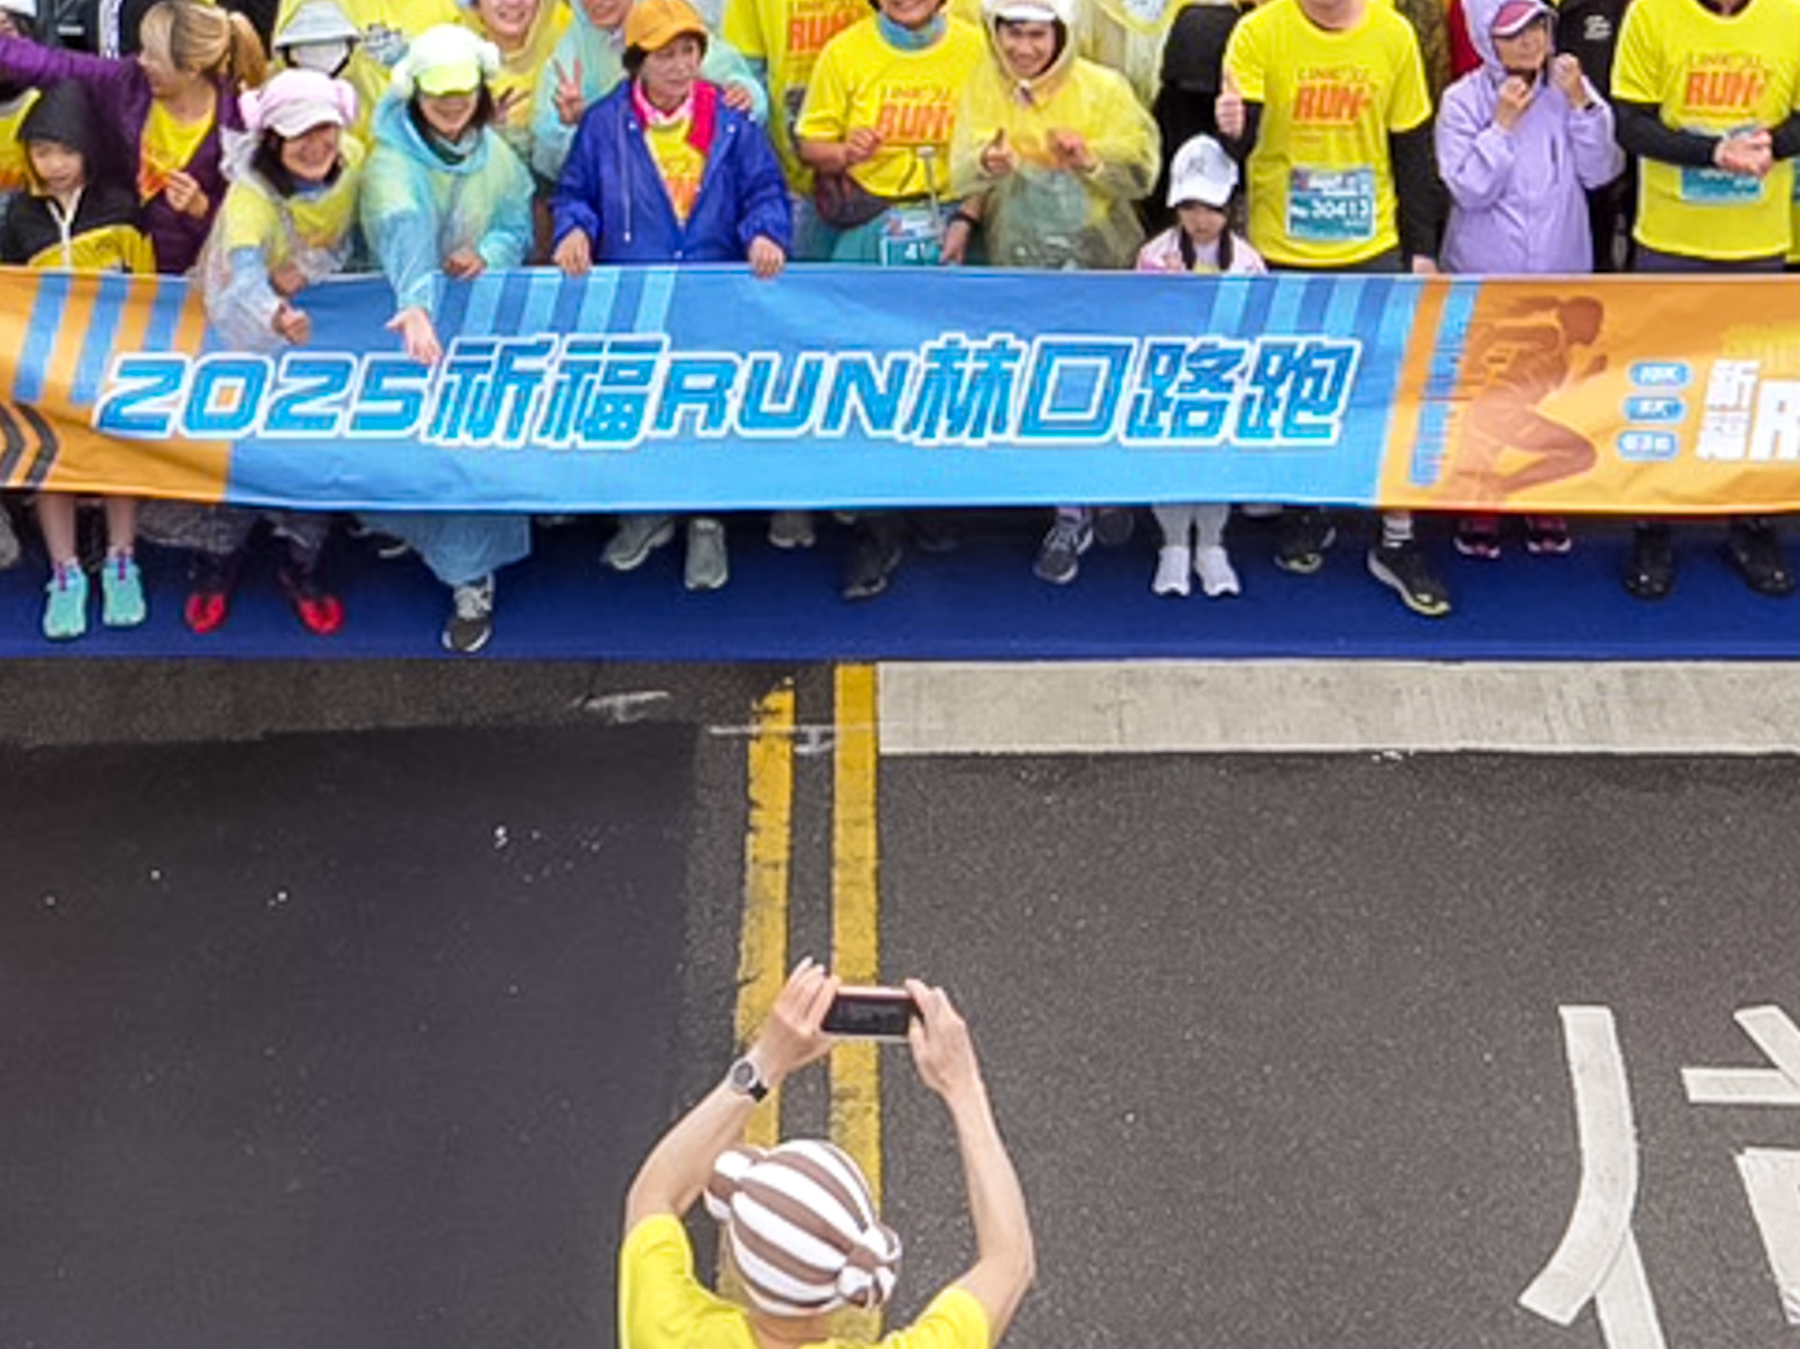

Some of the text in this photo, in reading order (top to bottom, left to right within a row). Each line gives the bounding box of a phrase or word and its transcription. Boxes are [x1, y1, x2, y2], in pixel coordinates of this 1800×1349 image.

[95, 335, 1362, 449] 2025祈福RUN林口路跑
